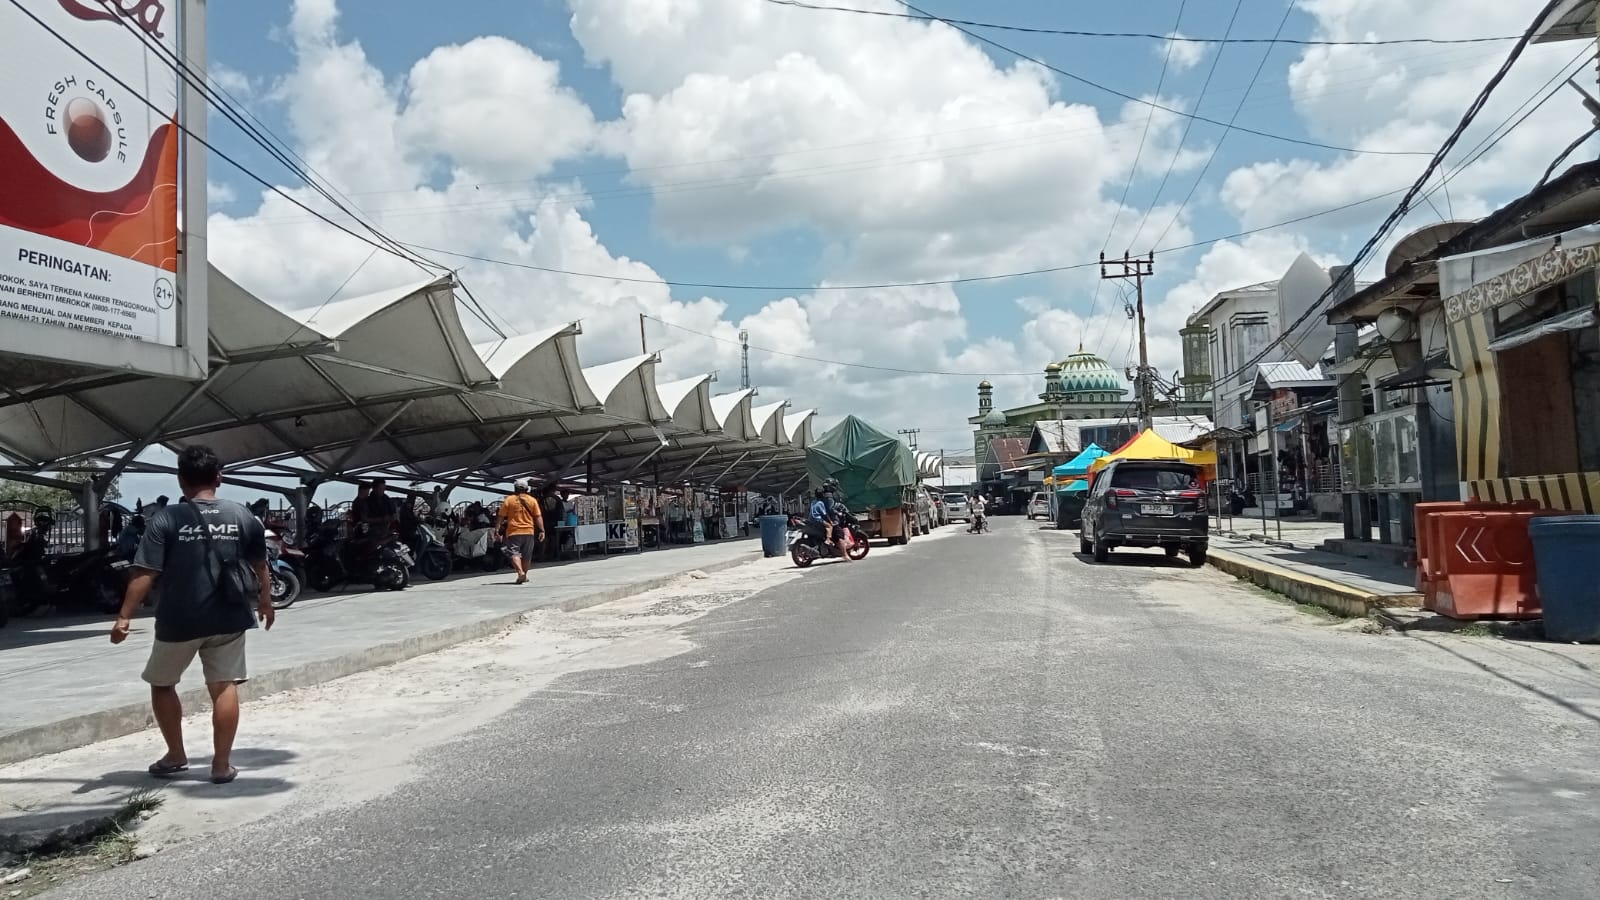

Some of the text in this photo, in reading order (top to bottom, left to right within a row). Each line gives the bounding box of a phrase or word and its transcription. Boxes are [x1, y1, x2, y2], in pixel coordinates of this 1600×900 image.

[45, 75, 129, 164] FRESH CAPSULE
[18, 248, 112, 282] PERINGATAN:
[17, 287, 55, 301] BERHENTI
[55, 295, 91, 309] MEROKOK
[29, 279, 49, 290] SAYA
[50, 284, 82, 298] TERKENA
[83, 291, 111, 303] KANKER
[156, 286, 173, 301] 21+
[21, 303, 55, 317] MENJUAL
[57, 310, 73, 320] DAN
[73, 314, 105, 326] MEMBERI
[107, 320, 133, 331] KEPADA
[41, 317, 65, 328] TAHUN
[68, 322, 83, 331] DAN
